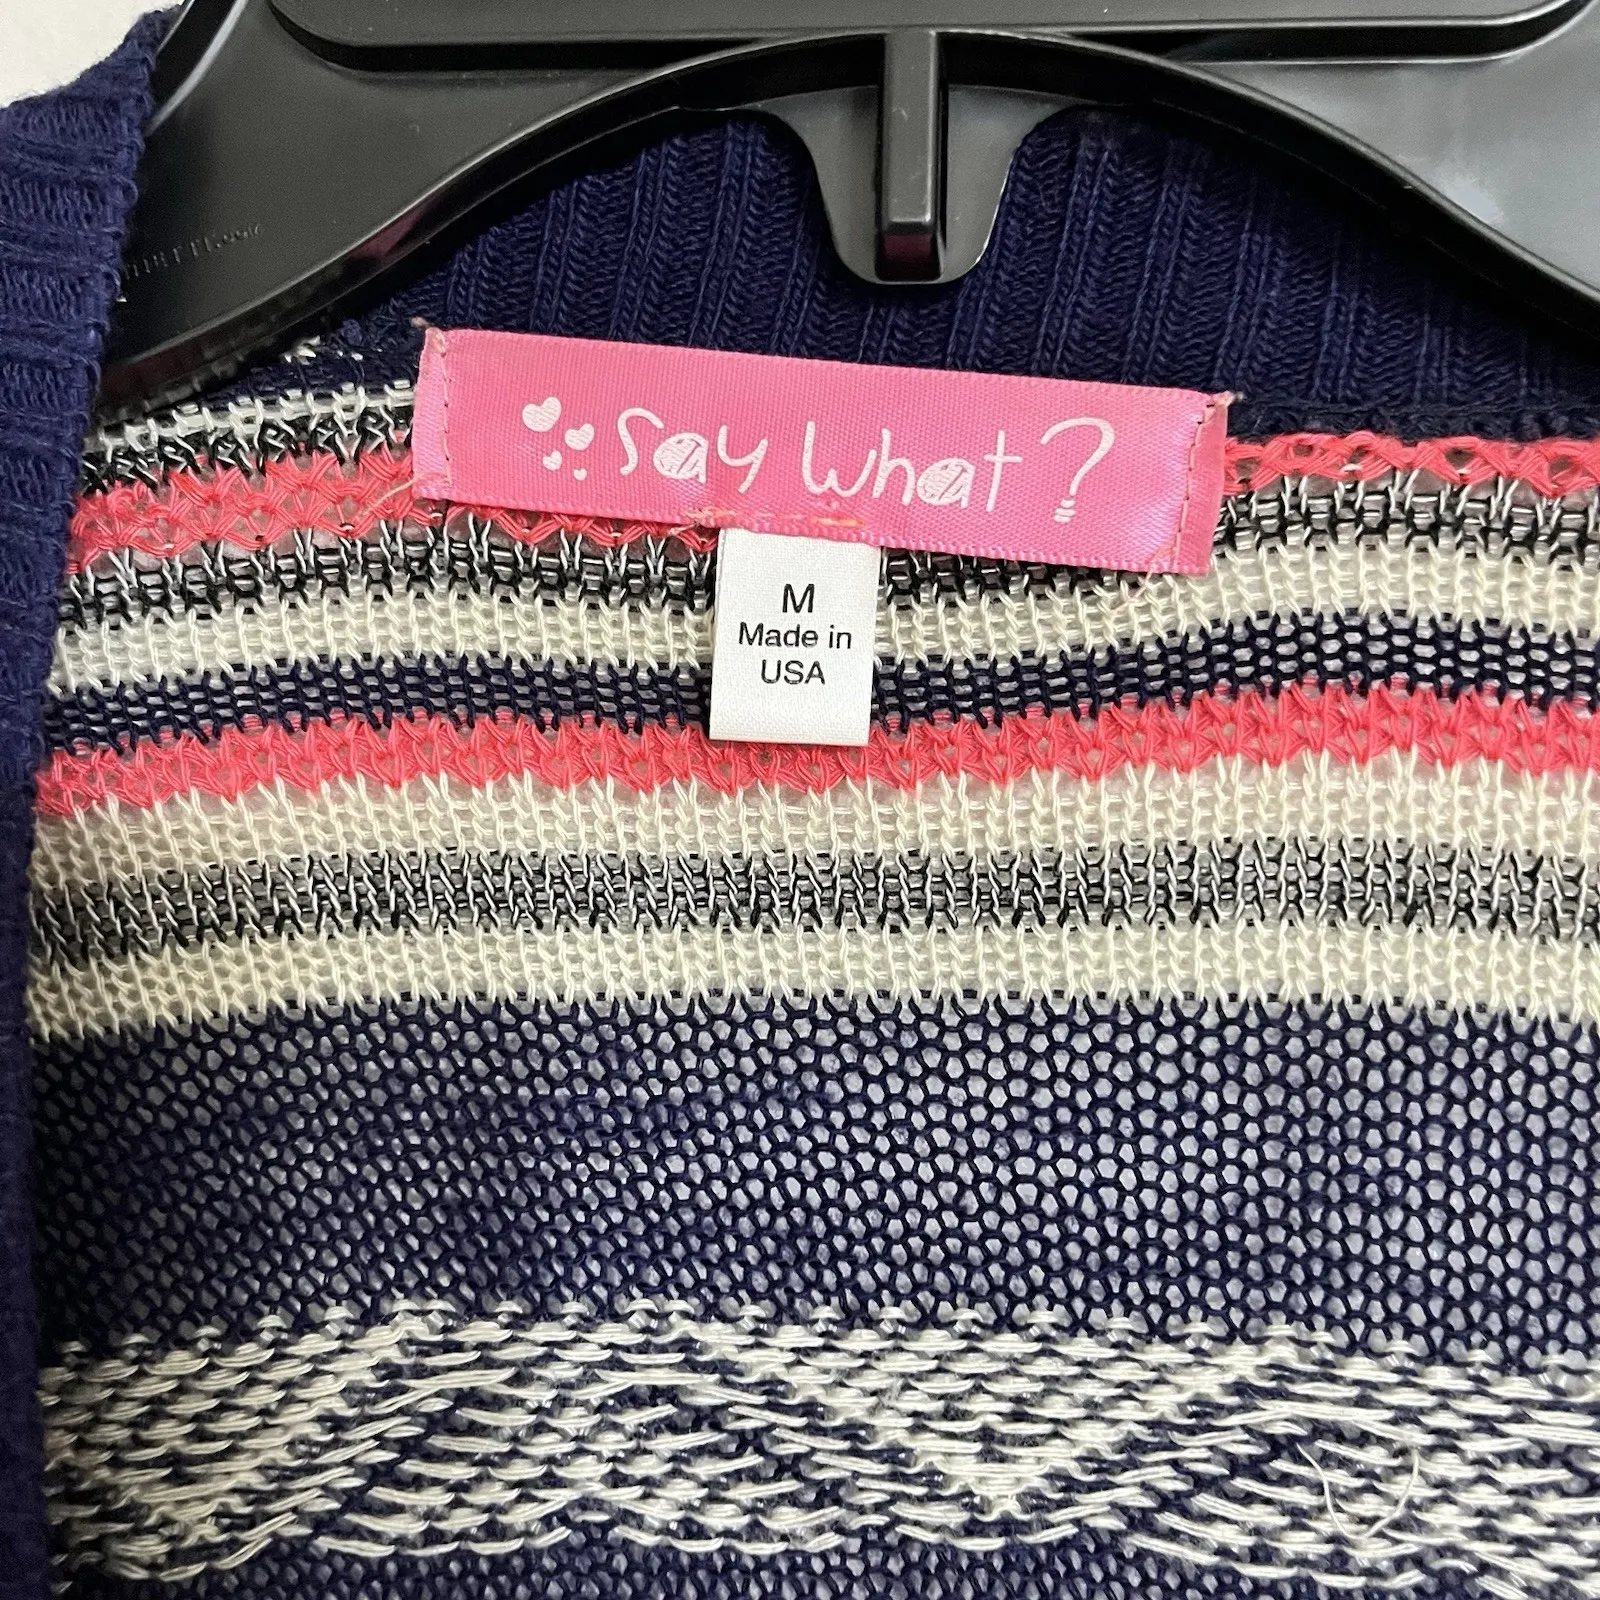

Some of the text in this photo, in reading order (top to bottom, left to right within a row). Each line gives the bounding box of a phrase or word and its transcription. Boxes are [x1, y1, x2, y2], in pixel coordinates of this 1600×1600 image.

[617, 407, 769, 494] Say
[782, 583, 815, 614] M
[738, 621, 852, 649] Made in
[760, 659, 826, 685] USA
